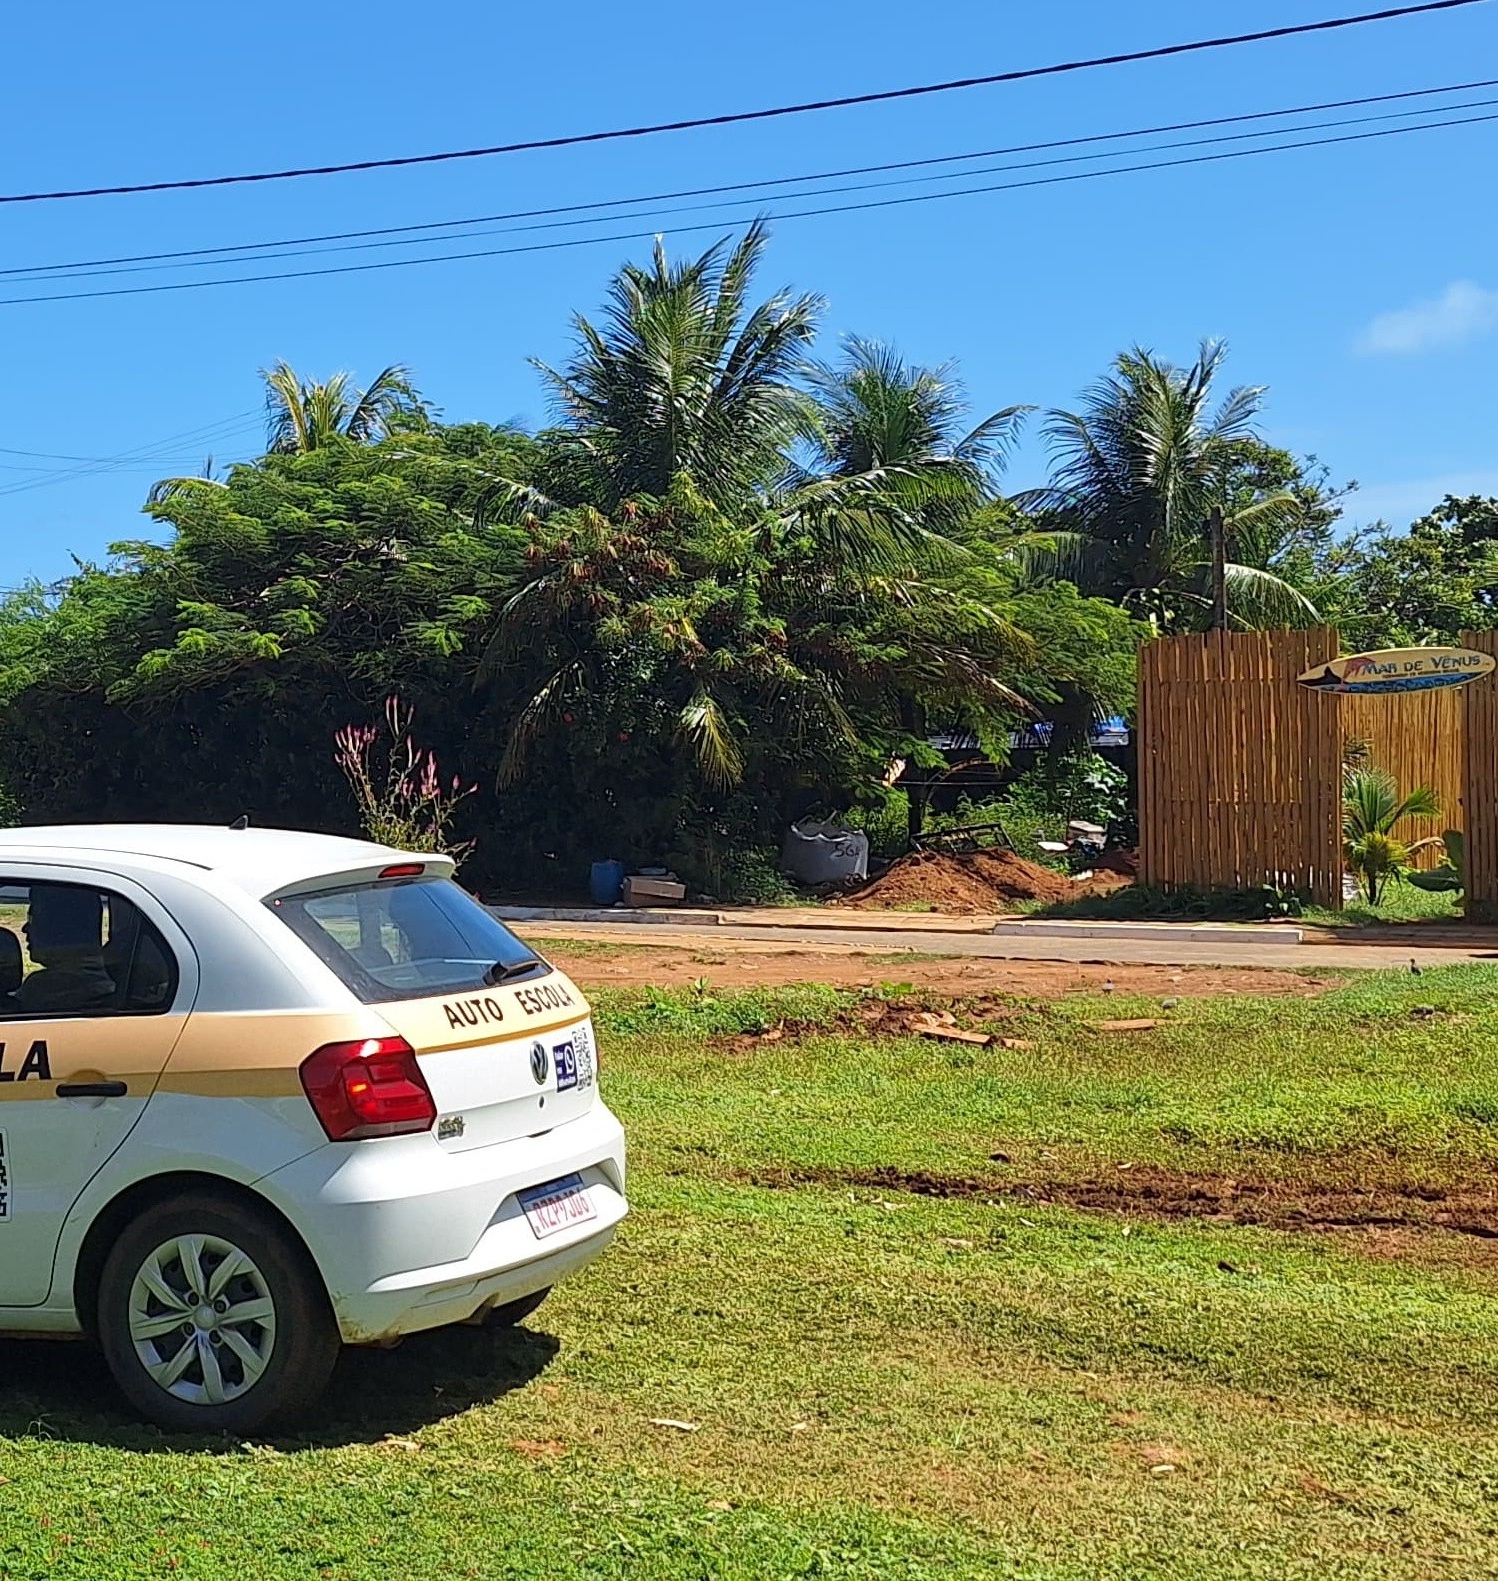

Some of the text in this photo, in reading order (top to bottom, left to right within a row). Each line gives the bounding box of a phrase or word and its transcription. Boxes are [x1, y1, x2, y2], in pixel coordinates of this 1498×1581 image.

[1363, 662, 1398, 675] MAR
[1403, 660, 1424, 673] DE
[442, 984, 574, 1029] AUTO ESCOLA
